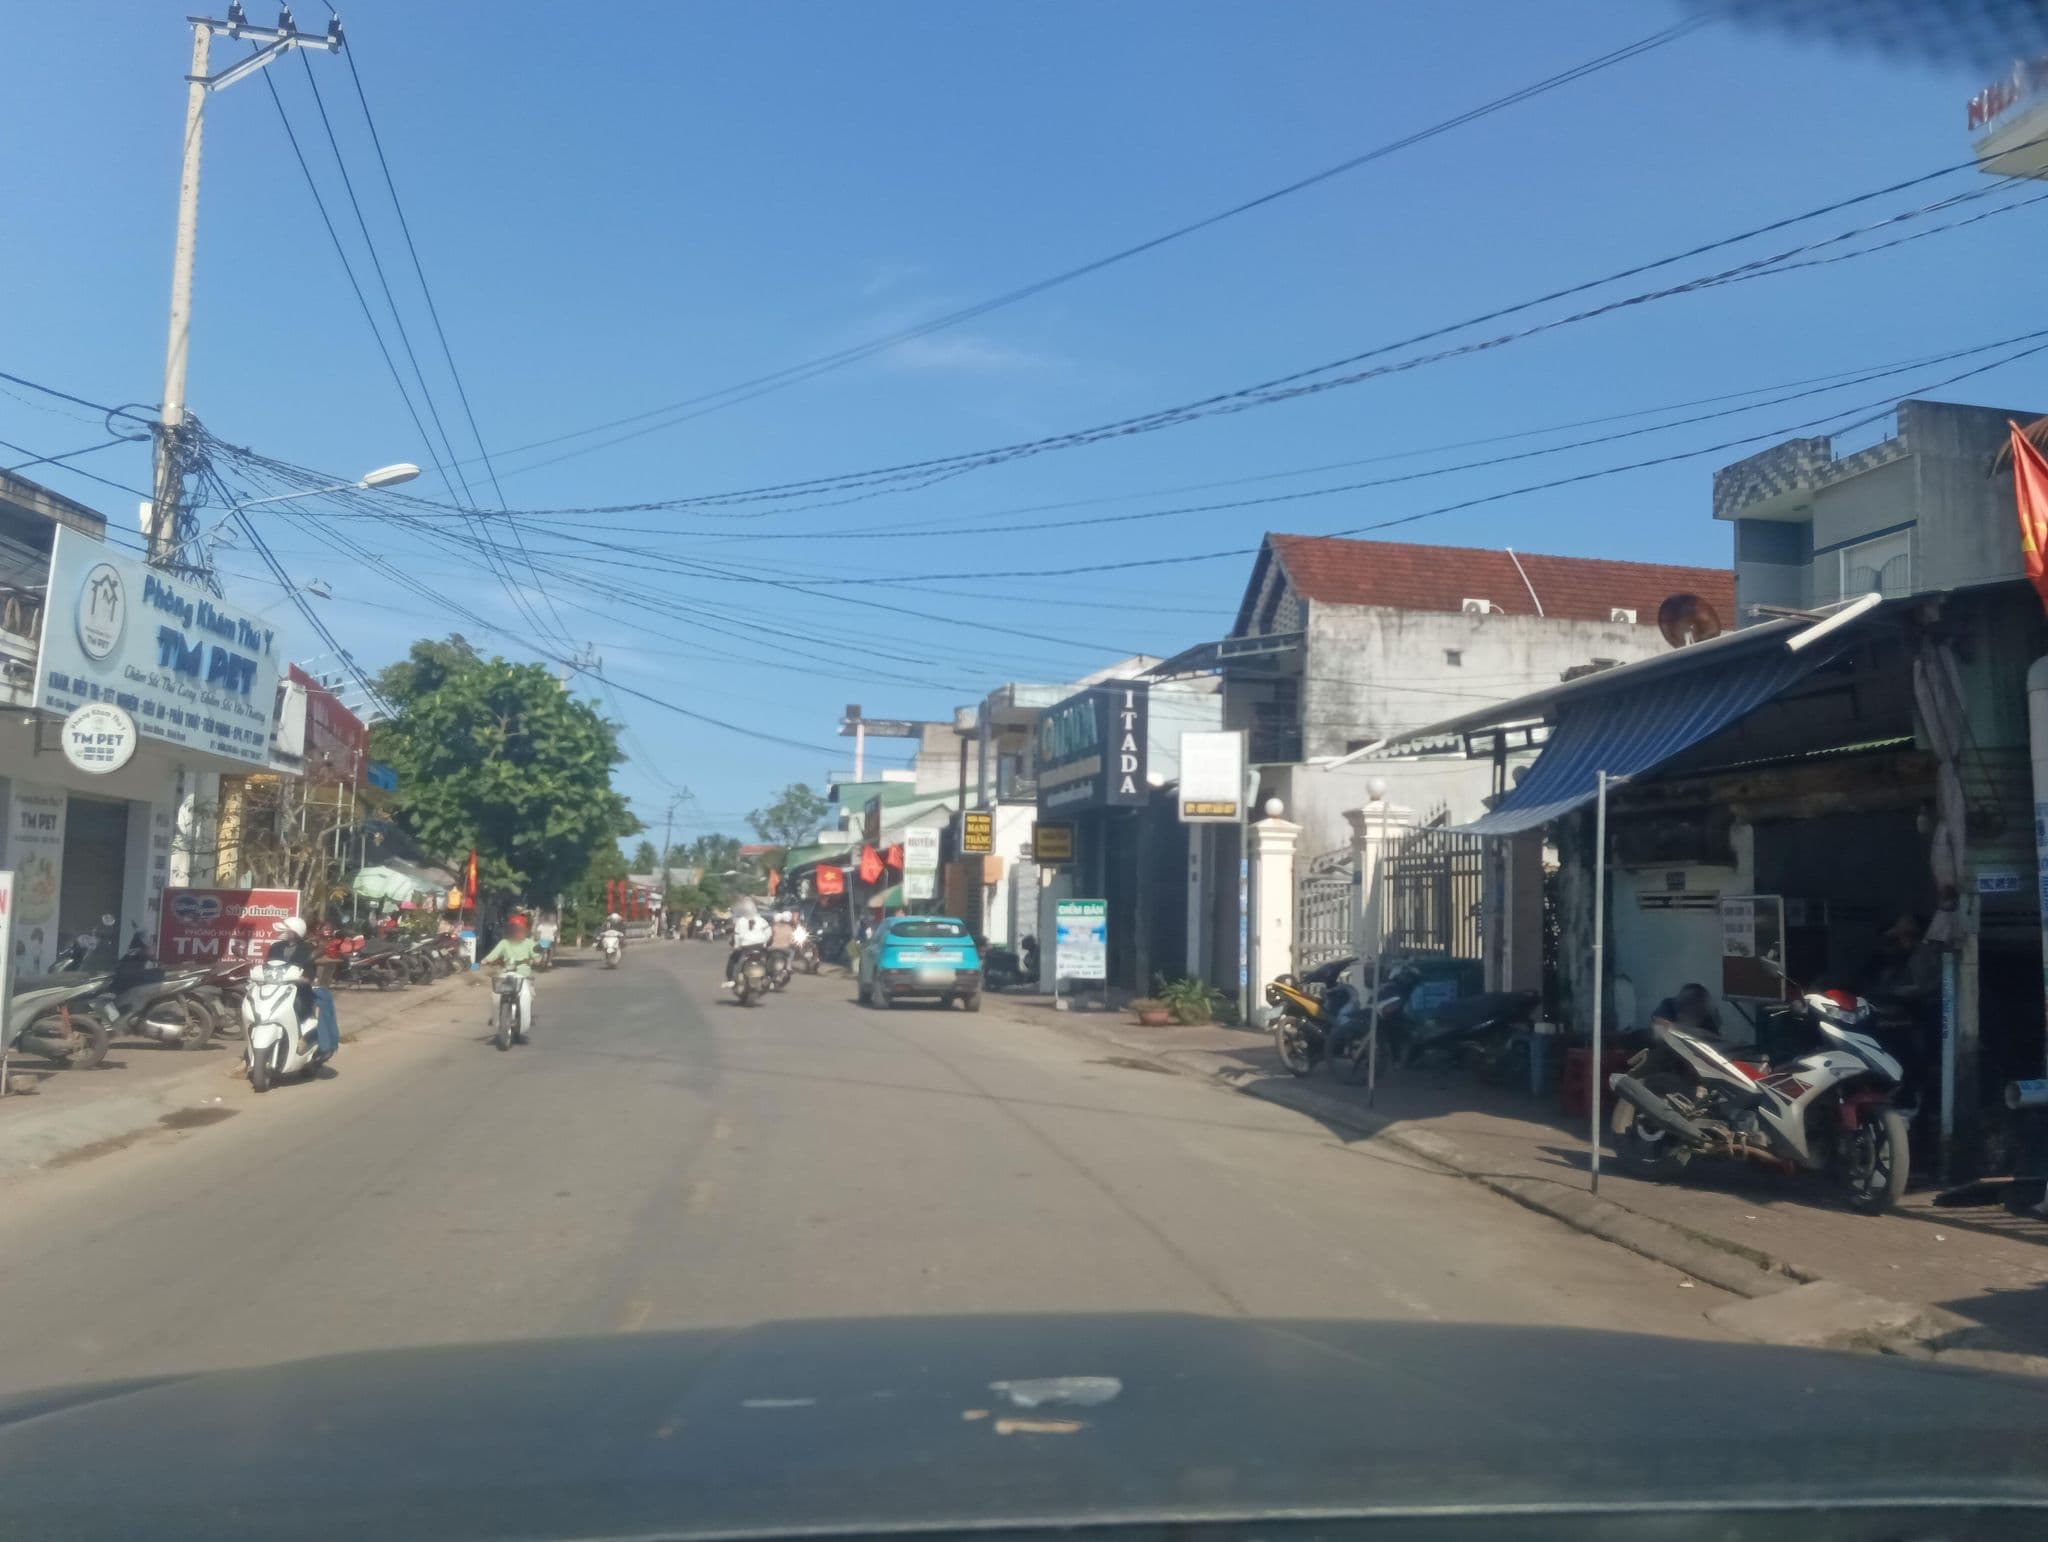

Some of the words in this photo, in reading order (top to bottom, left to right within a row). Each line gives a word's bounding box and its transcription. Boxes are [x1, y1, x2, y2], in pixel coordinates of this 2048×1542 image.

[143, 574, 193, 629] Phòng
[196, 599, 236, 641] Khám
[264, 628, 274, 656] Y
[157, 624, 202, 677] TM
[206, 645, 258, 695] PET
[72, 732, 93, 744] TM
[97, 733, 125, 746] PET
[21, 811, 37, 829] TM
[38, 813, 57, 831] PET
[172, 937, 220, 956] TM
